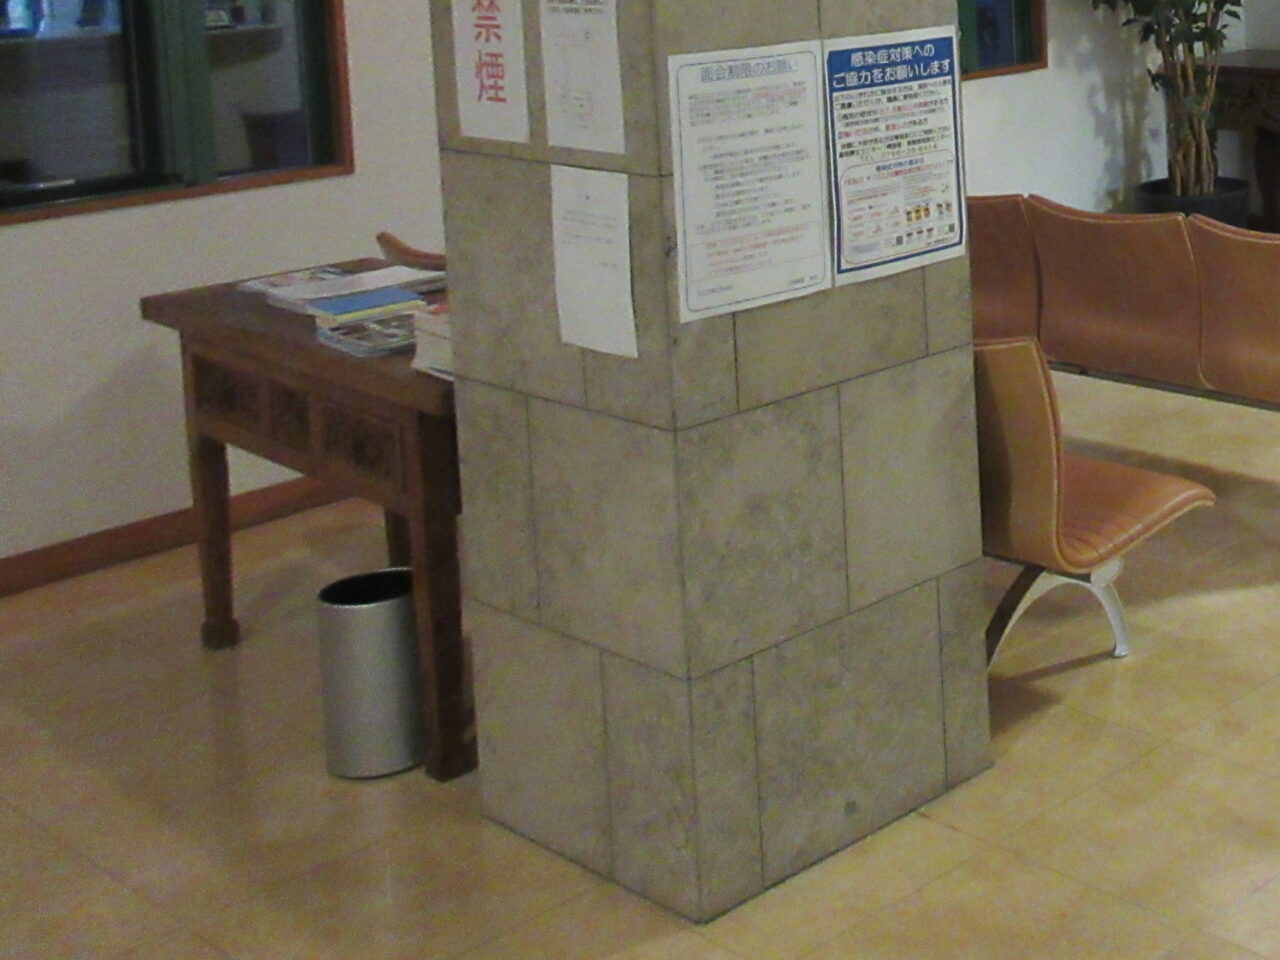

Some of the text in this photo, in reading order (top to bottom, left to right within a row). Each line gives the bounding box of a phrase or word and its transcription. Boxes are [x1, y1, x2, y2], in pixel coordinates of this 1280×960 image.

[850, 44, 934, 66] 感染症対策への
[832, 59, 951, 88] ご協力をお願いします
